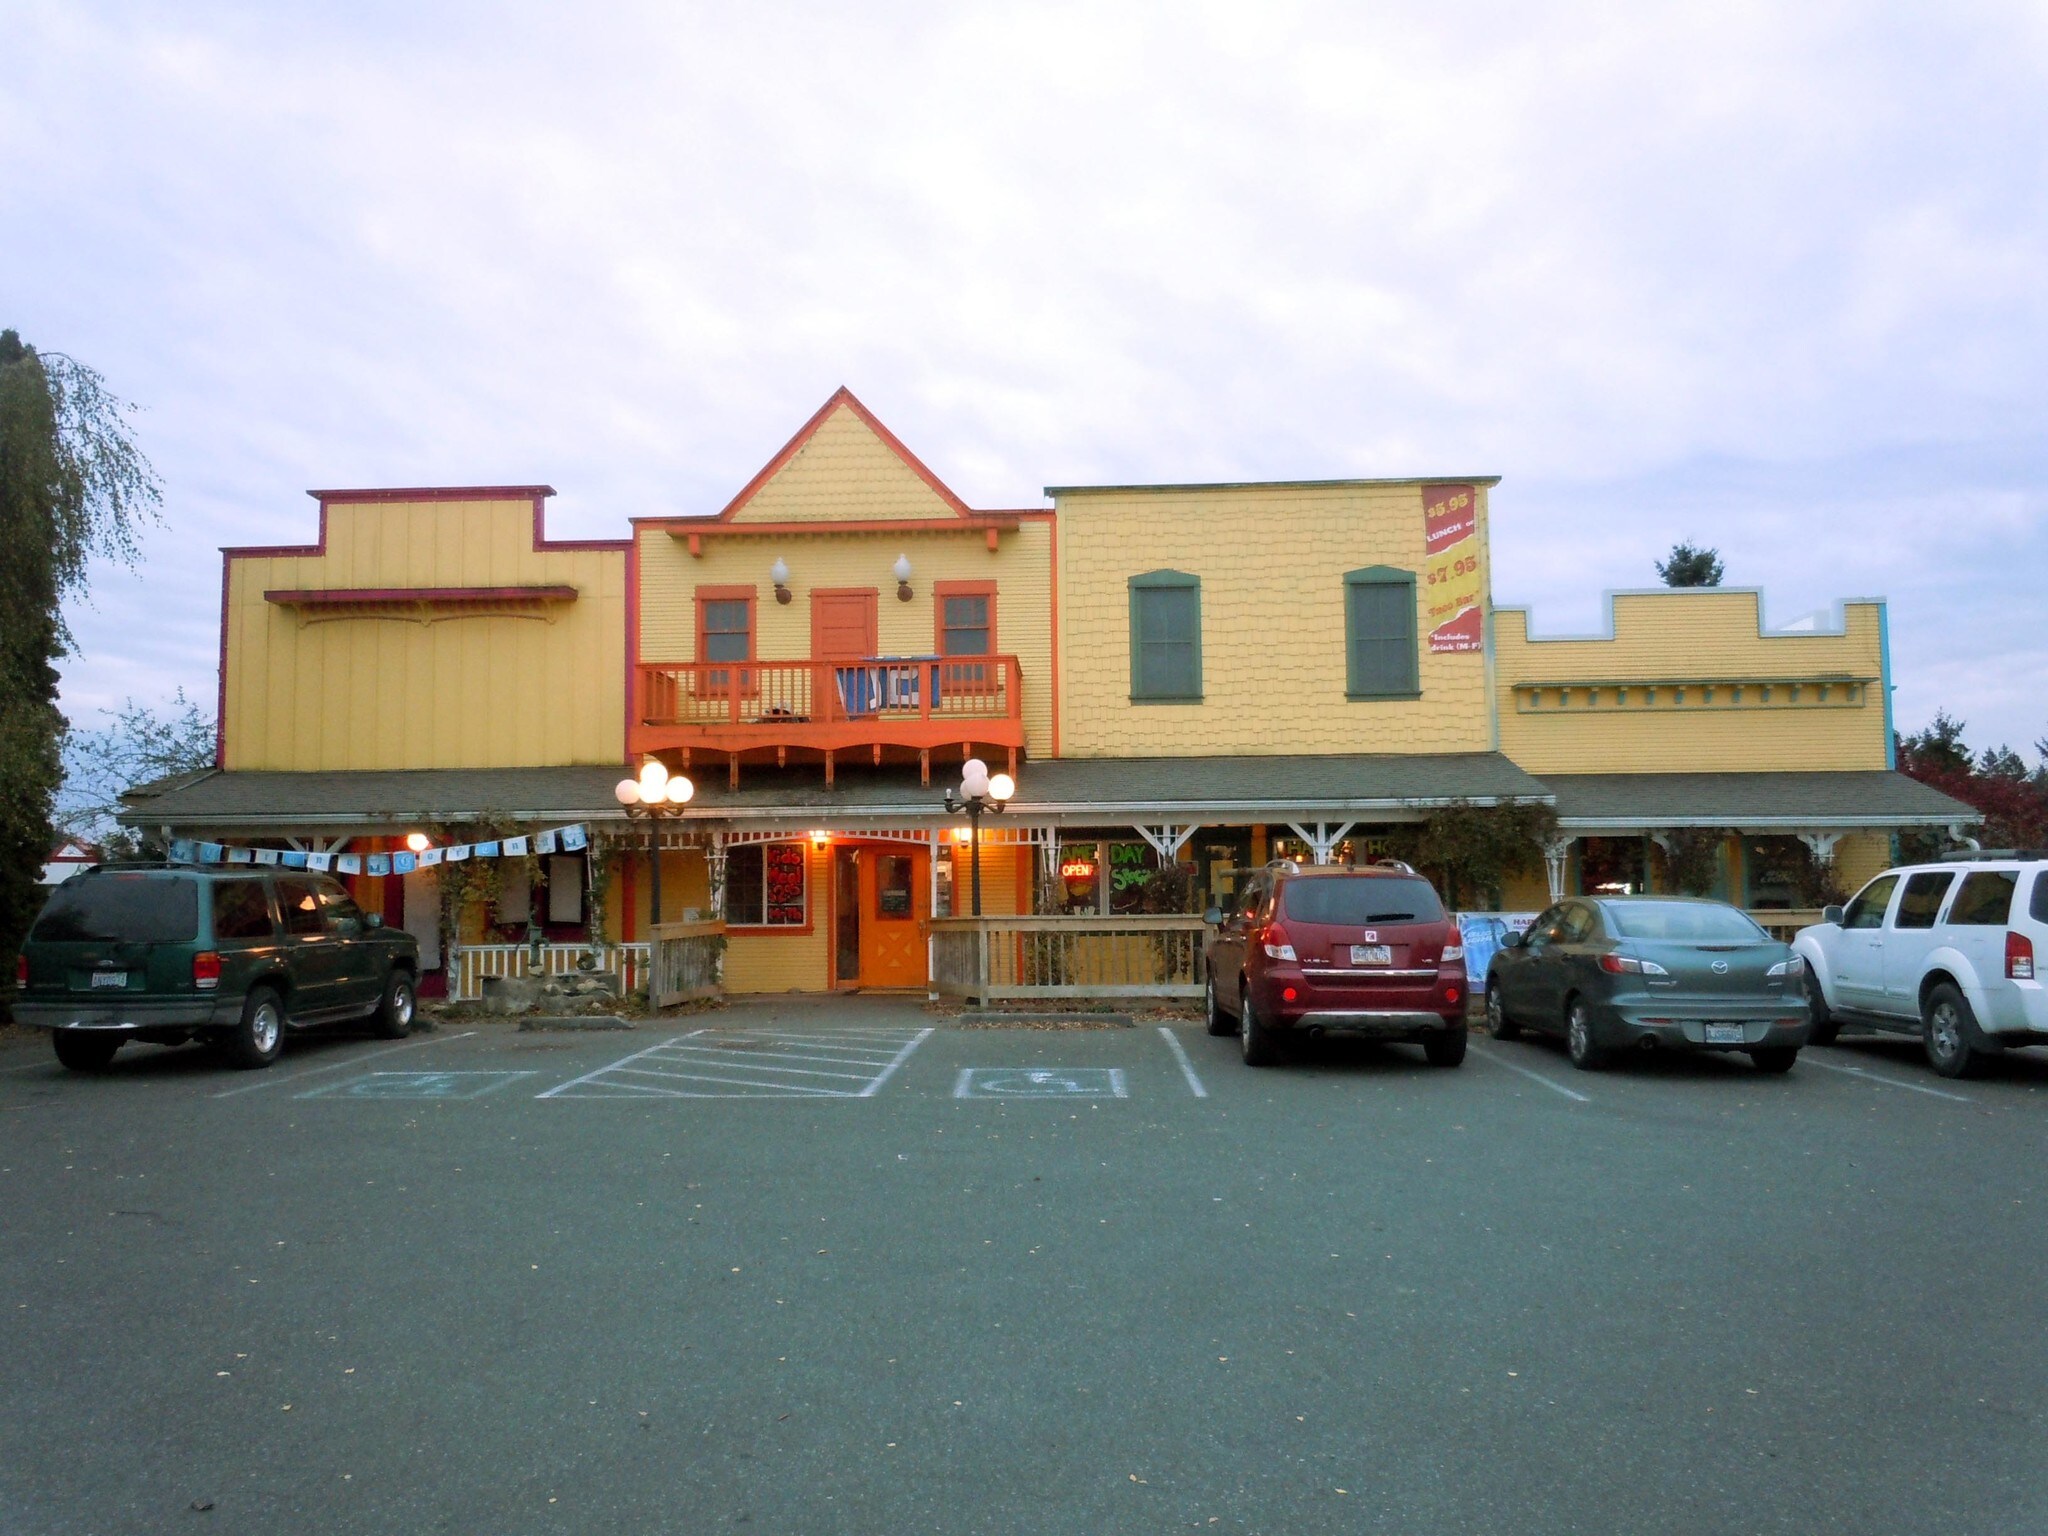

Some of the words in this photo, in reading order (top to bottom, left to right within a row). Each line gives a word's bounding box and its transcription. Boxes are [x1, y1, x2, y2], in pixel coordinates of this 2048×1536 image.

[1426, 523, 1462, 542] LUNCH
[1427, 555, 1477, 585] $7.95
[1428, 603, 1453, 617] Taco
[1111, 845, 1146, 863] DAY
[1062, 864, 1089, 877] OPEN
